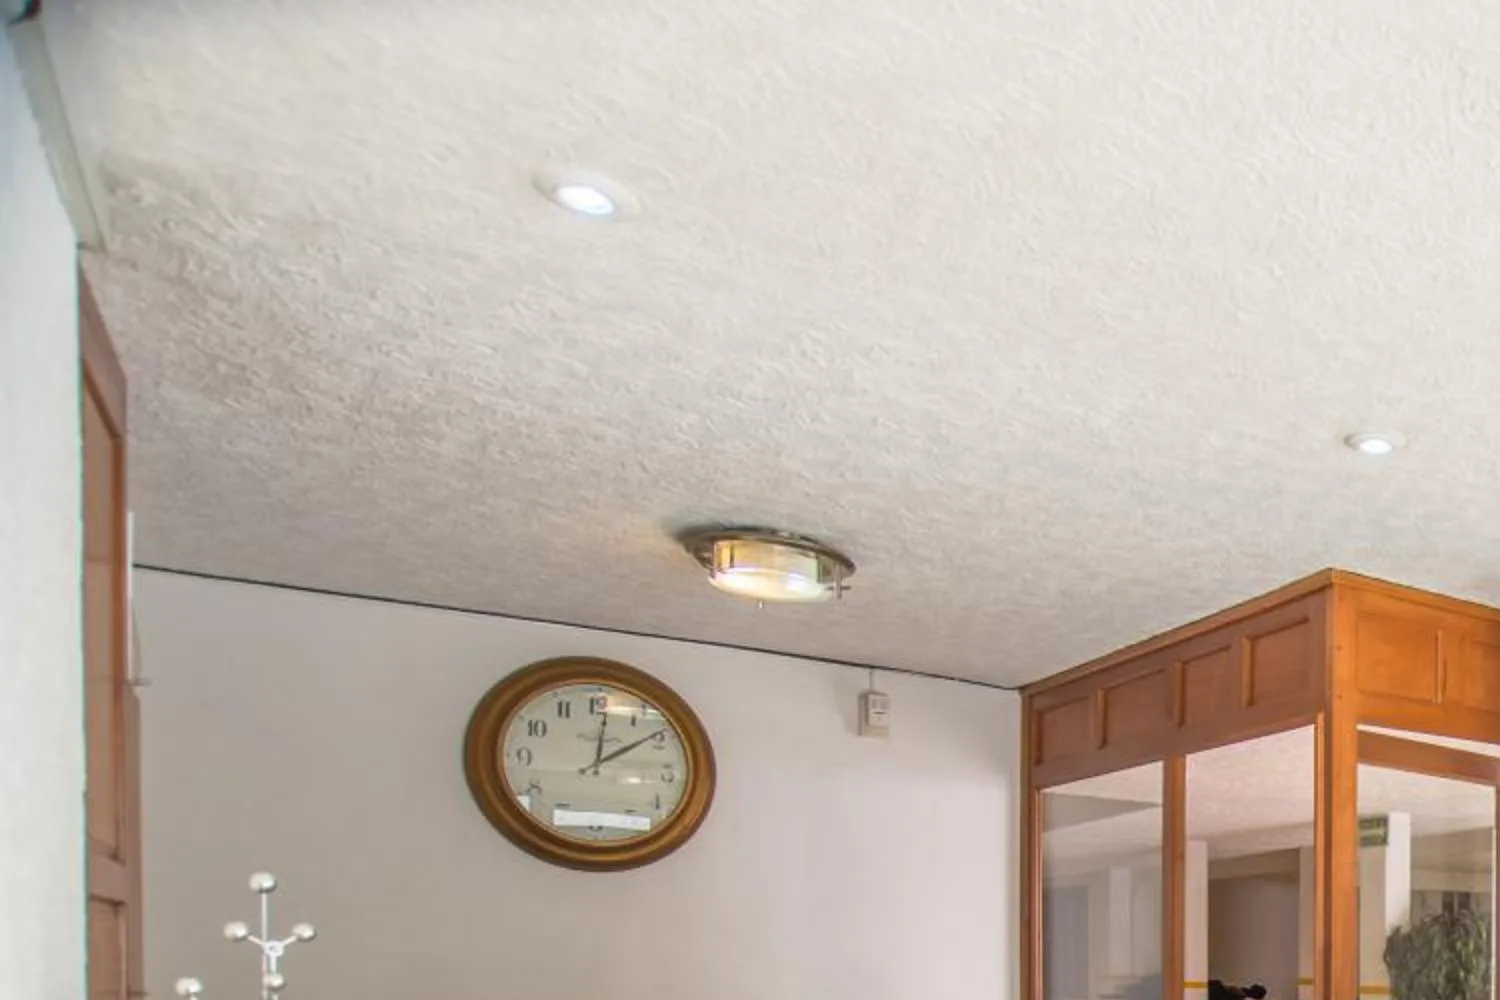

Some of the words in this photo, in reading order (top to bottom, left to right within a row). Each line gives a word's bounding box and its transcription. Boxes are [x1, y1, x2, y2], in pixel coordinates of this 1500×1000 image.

[557, 701, 570, 719] 11
[528, 719, 547, 737] 10
[516, 747, 533, 766] 9
